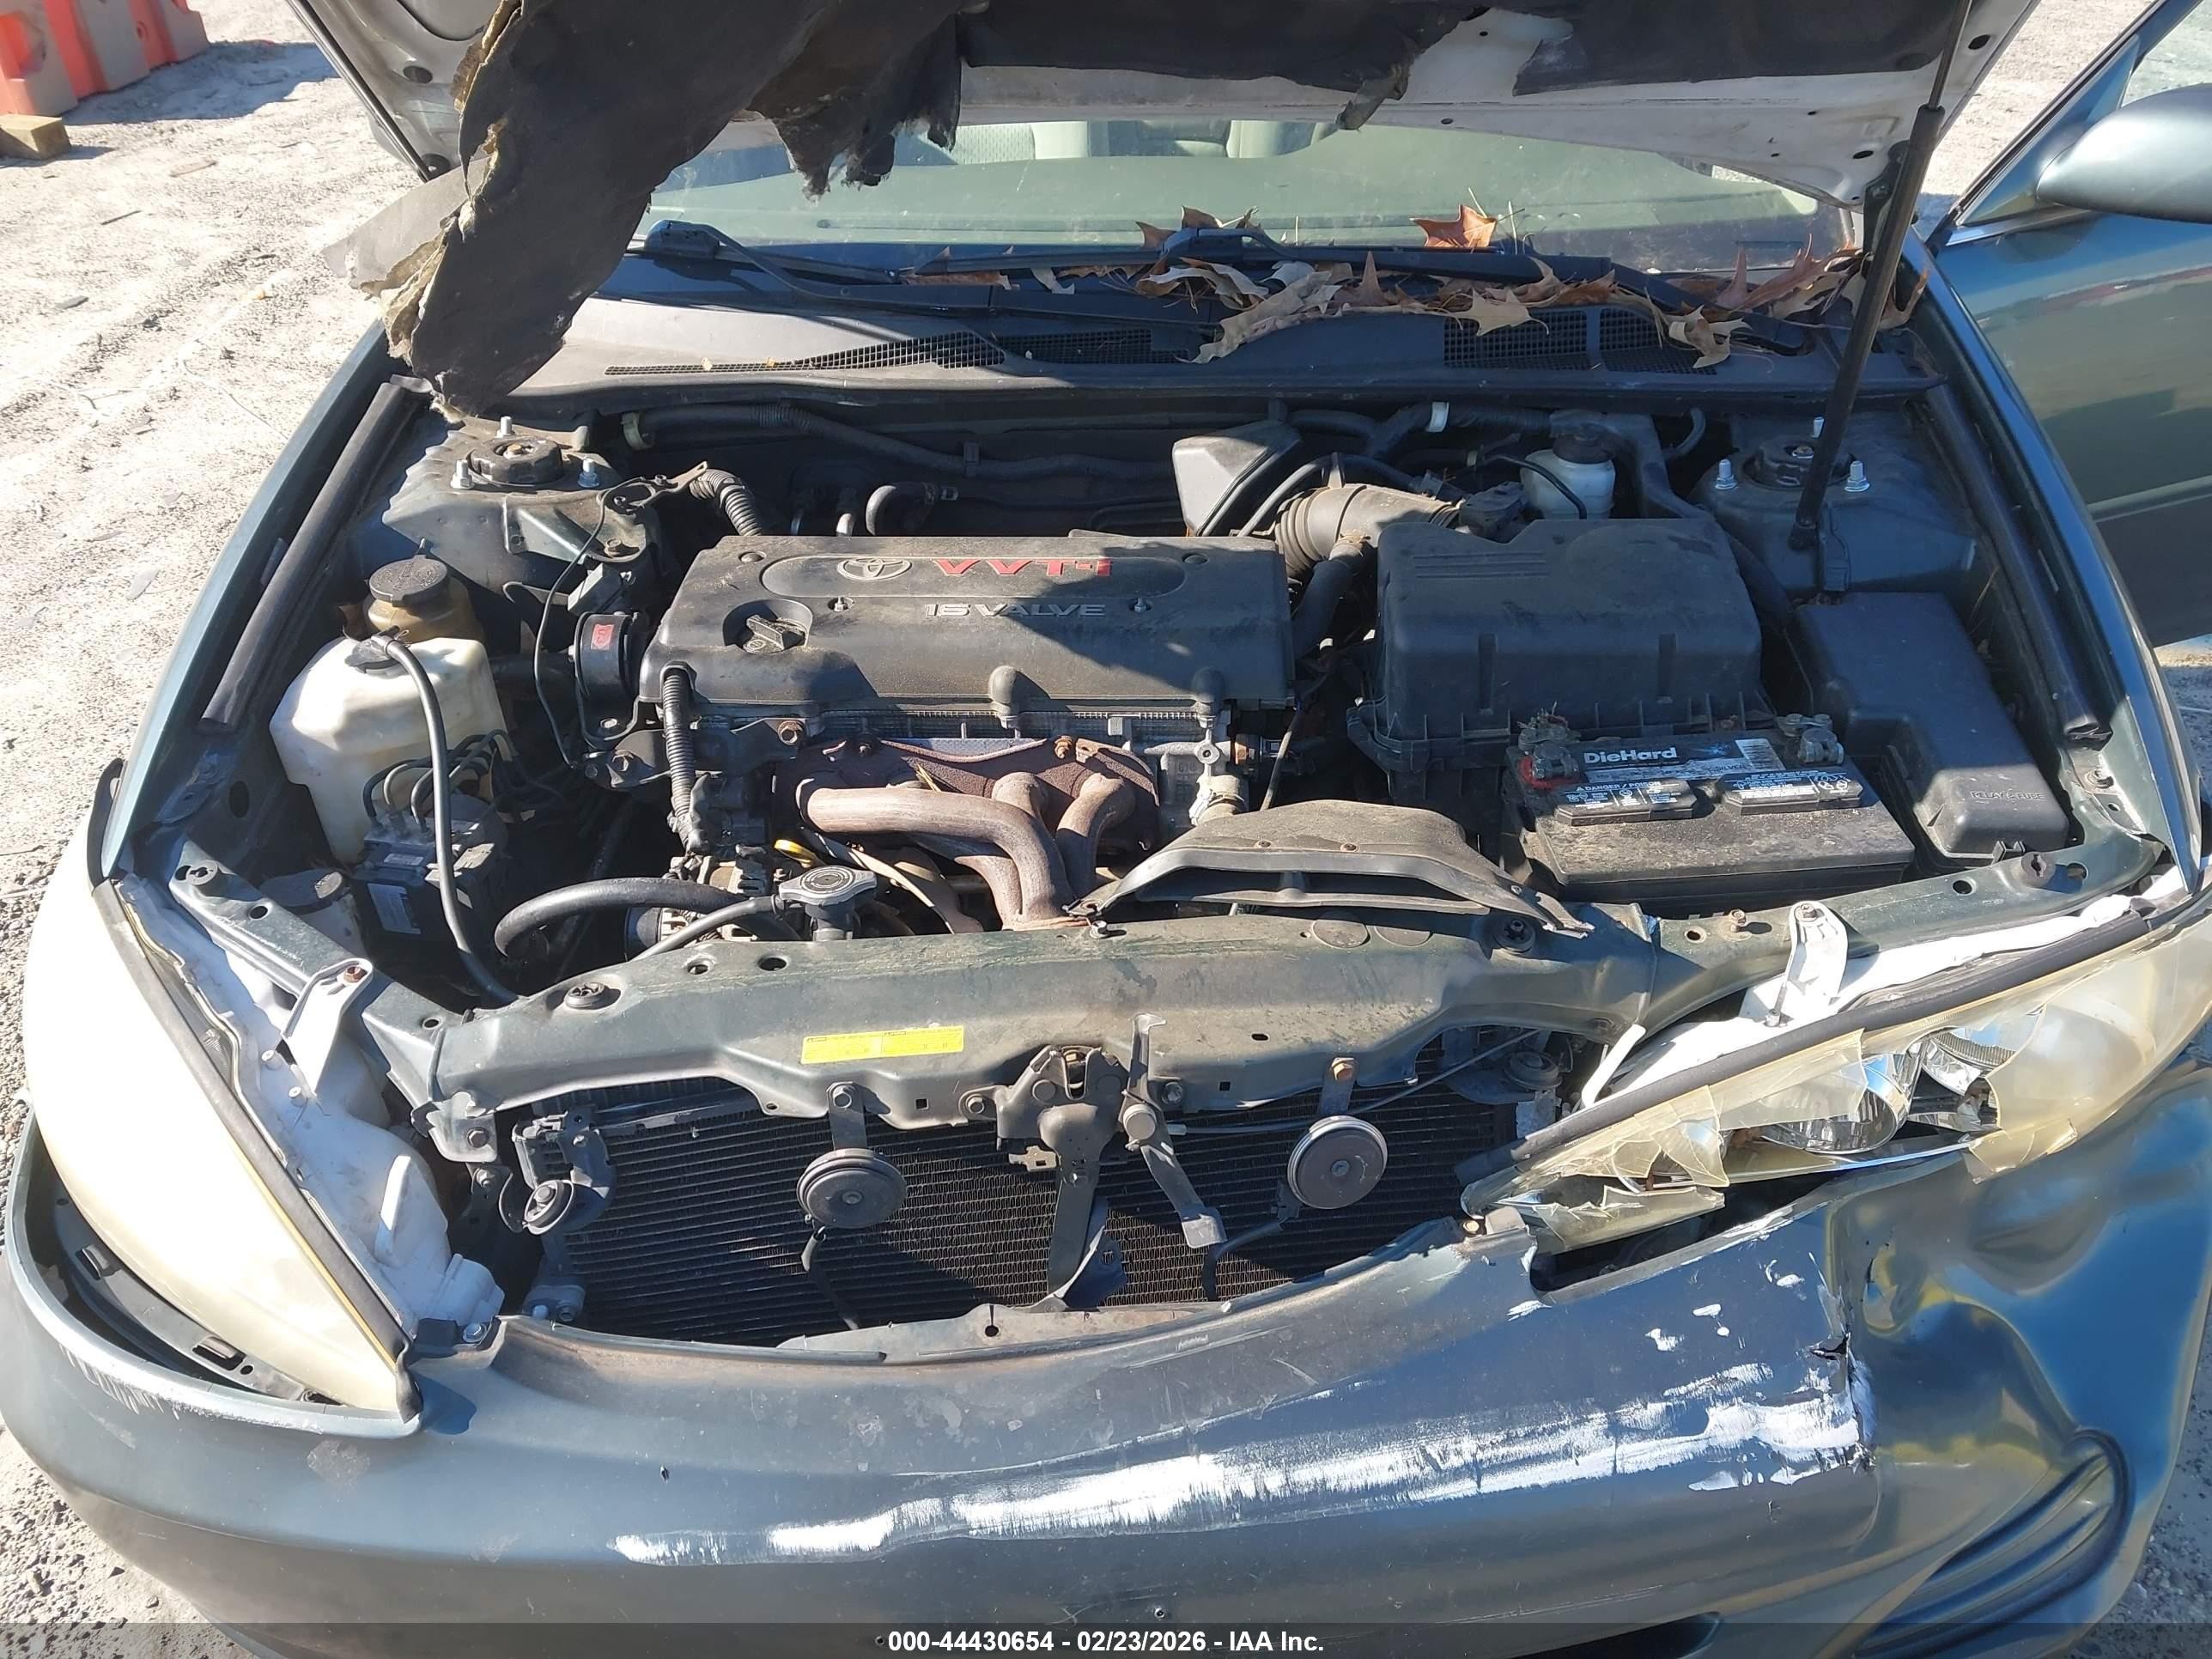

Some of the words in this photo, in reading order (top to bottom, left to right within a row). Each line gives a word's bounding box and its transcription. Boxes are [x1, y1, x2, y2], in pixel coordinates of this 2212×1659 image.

[975, 604, 1106, 617] VALVE
[1583, 747, 1678, 764] DieHard
[1970, 790, 2003, 799] RELAY
[2016, 792, 2045, 800] FUSE
